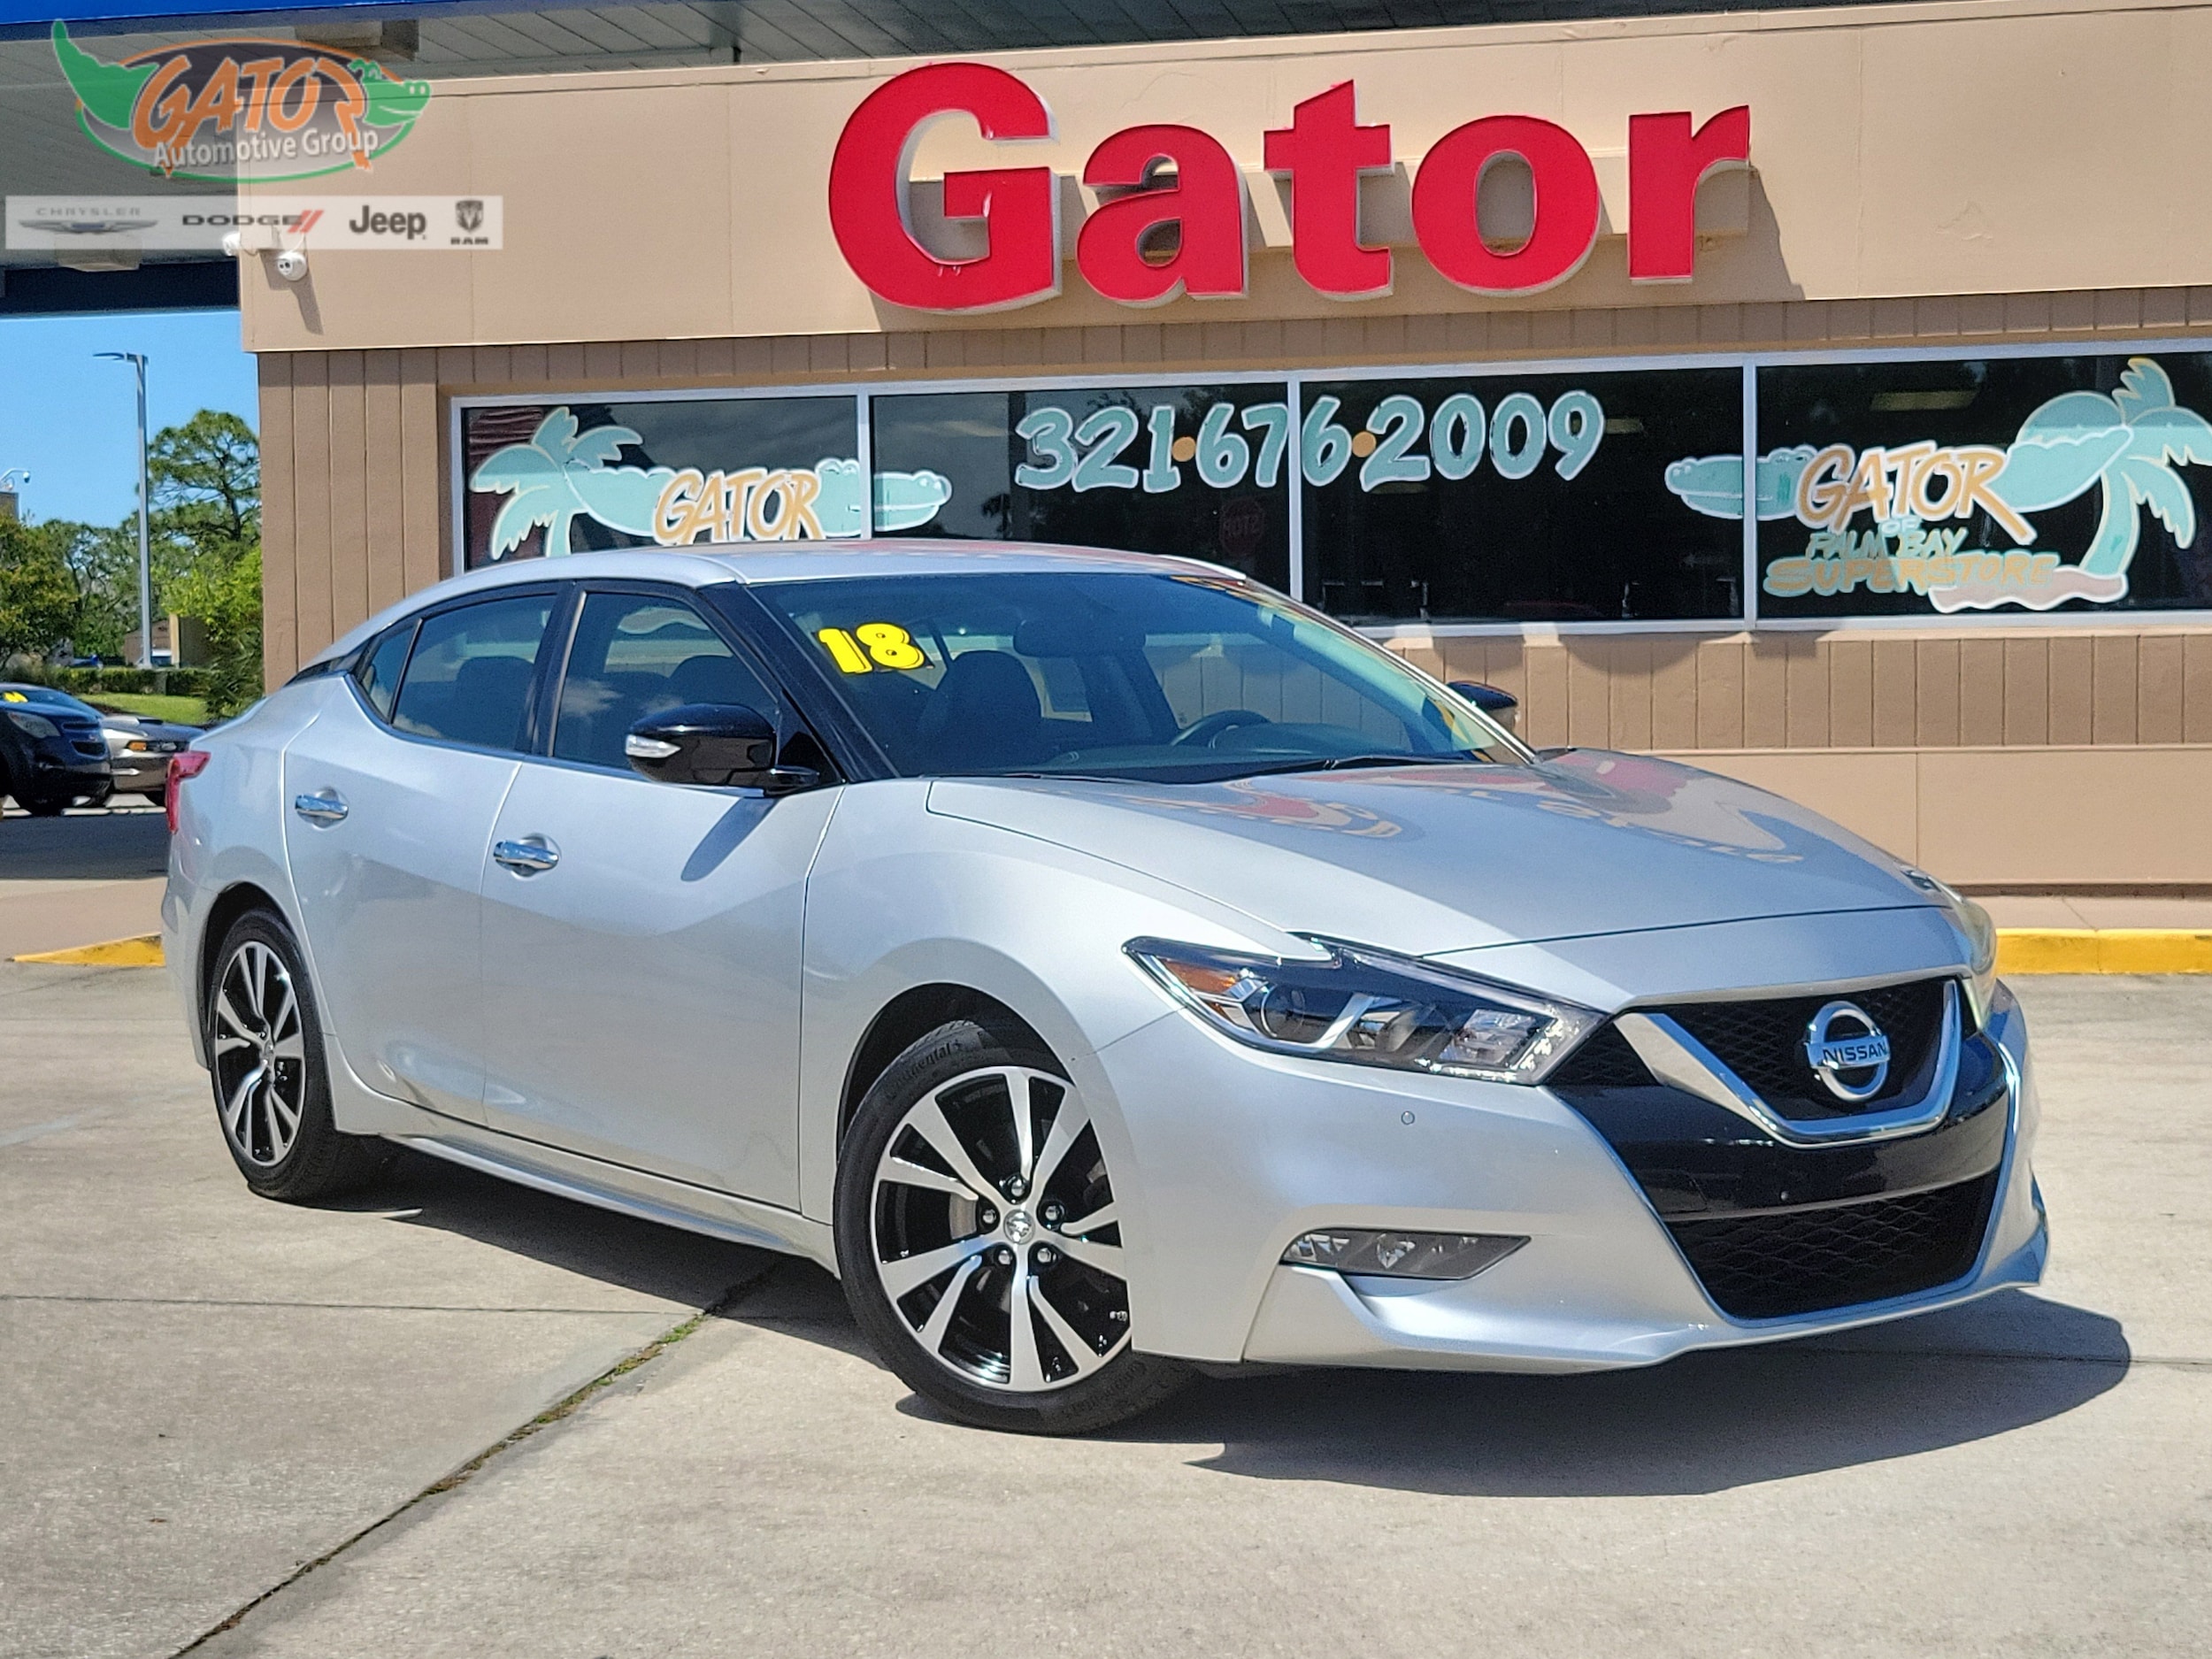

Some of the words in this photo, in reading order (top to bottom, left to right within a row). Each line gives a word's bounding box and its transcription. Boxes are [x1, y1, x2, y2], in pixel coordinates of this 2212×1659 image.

[828, 62, 1752, 314] Gator
[653, 467, 825, 546] GATOR
[1795, 441, 2036, 544] GATOR
[1805, 530, 1889, 559] PALM
[1897, 527, 1969, 558] BAY
[1880, 518, 1922, 537] OF
[1763, 549, 2061, 597] SUPERSTORE
[818, 622, 926, 674] 18
[1823, 1042, 1887, 1061] NISSAN
